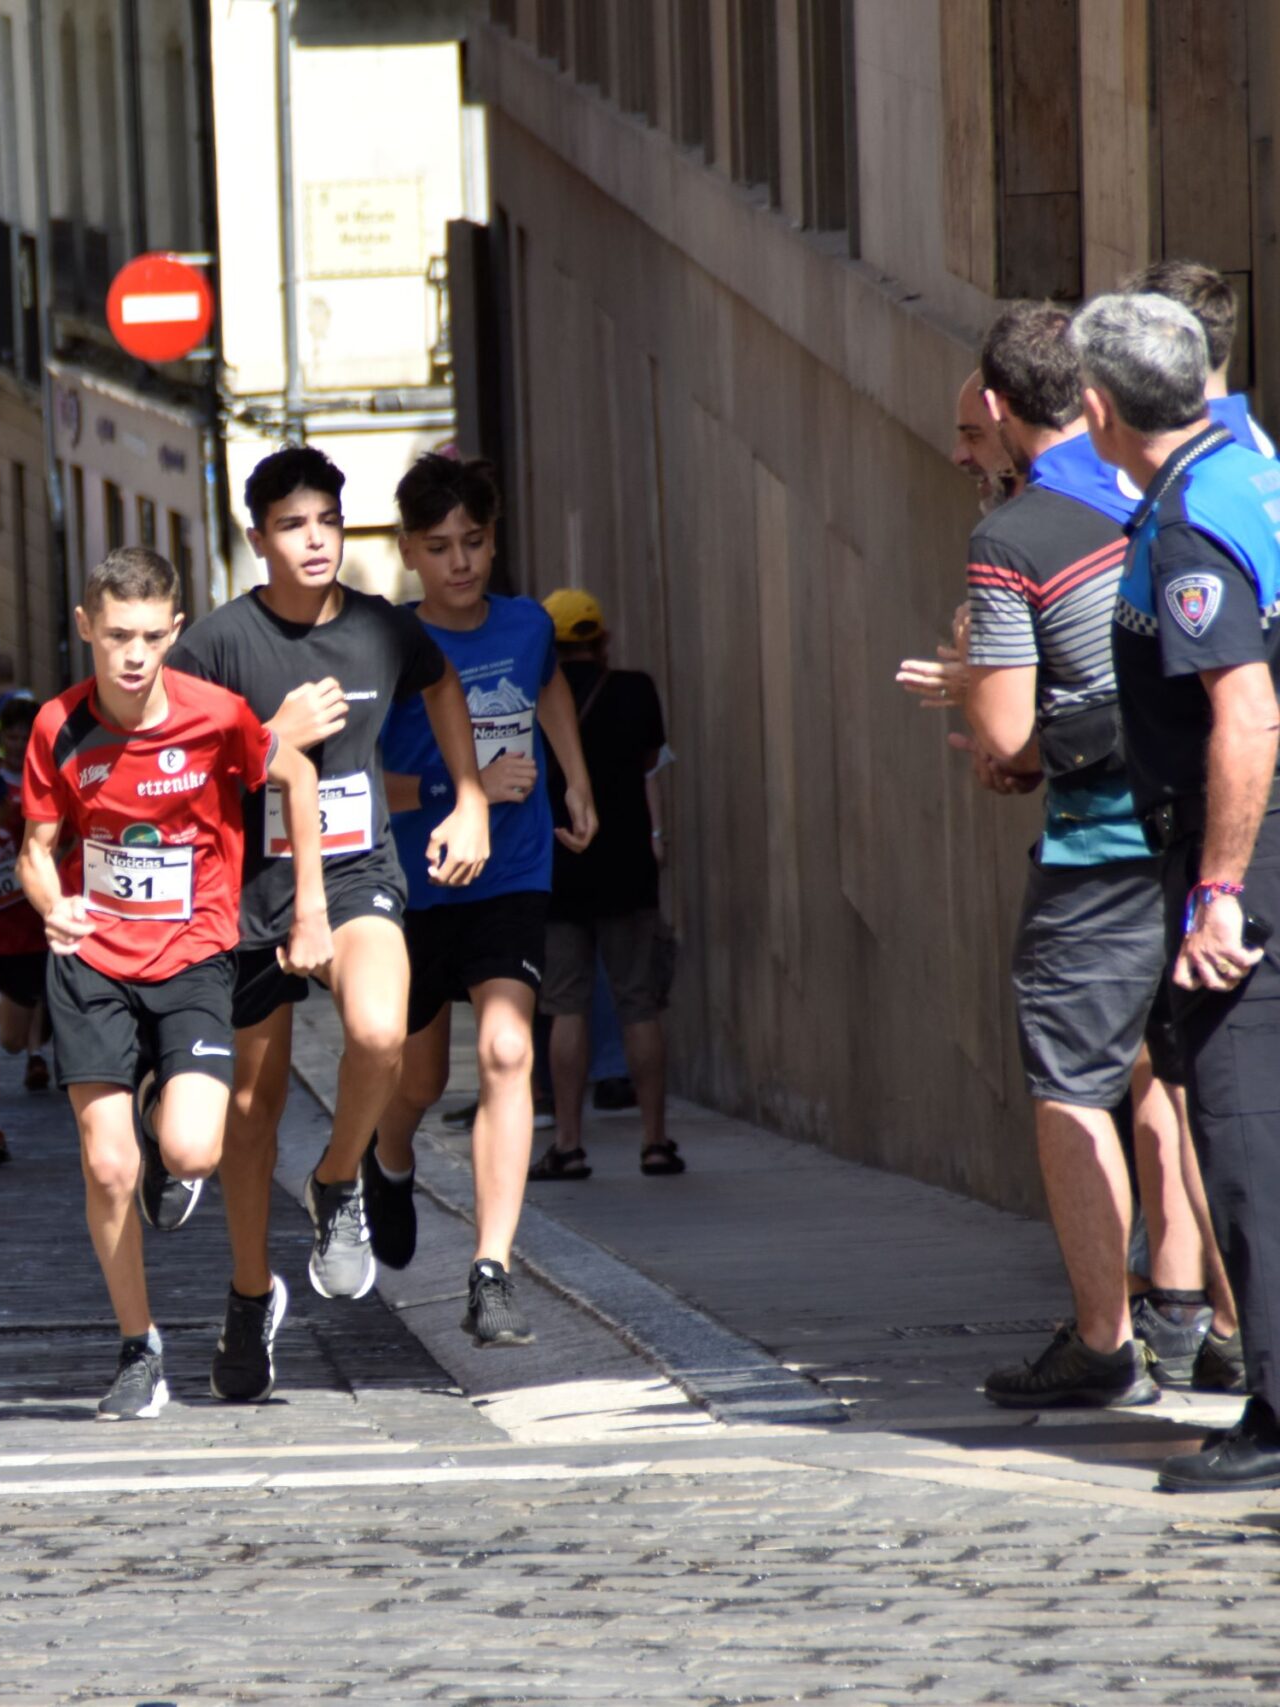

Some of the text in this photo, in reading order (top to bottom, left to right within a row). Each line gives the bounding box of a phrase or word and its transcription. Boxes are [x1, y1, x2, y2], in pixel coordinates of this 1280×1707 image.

[473, 724, 519, 740] Noticias
[106, 854, 162, 870] Noticias
[113, 875, 153, 900] 31
